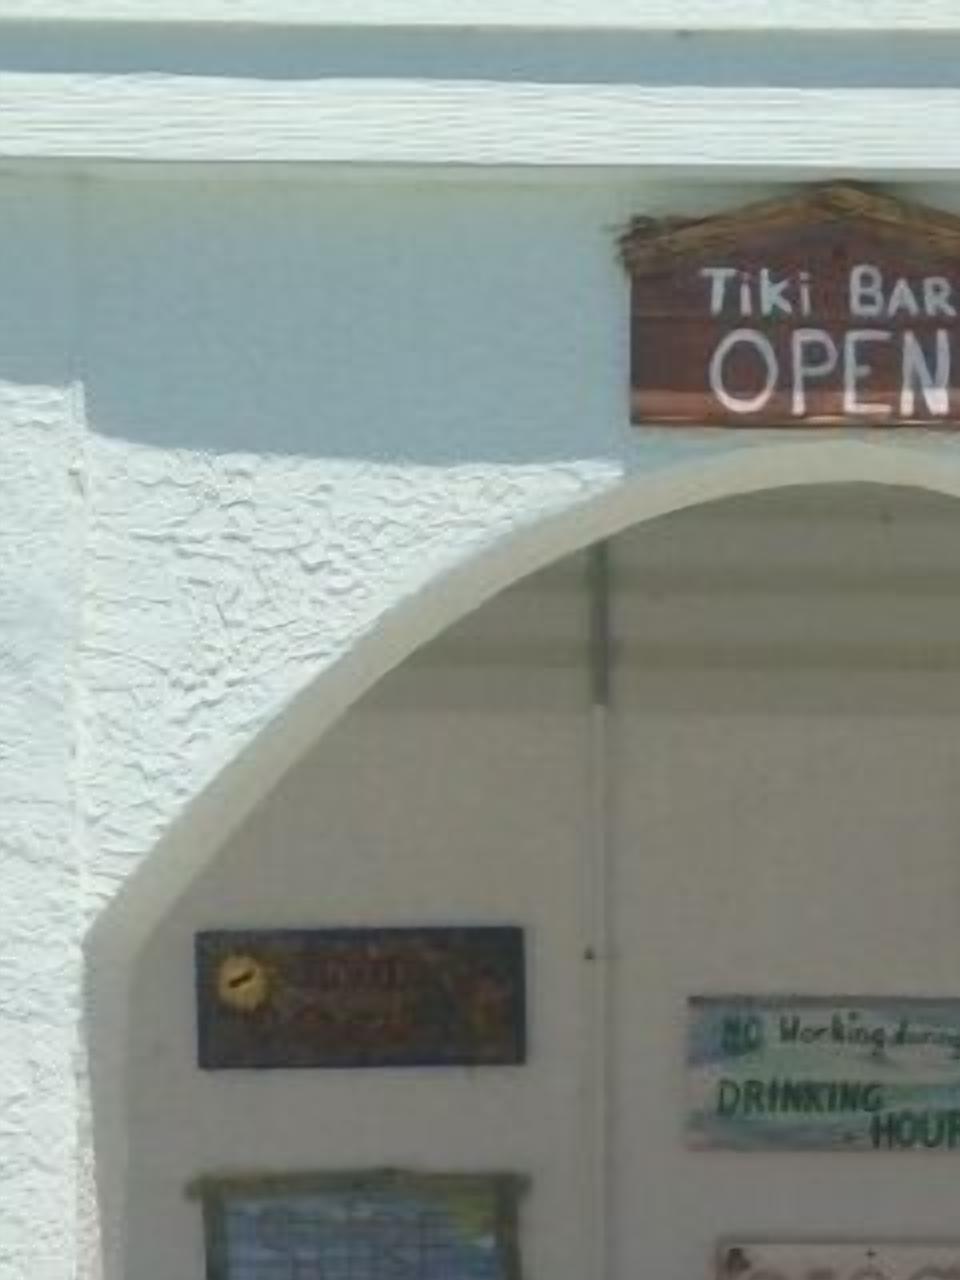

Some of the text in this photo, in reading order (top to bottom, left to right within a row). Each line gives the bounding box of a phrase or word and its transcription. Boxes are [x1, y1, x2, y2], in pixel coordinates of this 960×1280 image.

[702, 264, 957, 317] Tiki BAR
[709, 327, 952, 416] OPEN
[716, 1079, 885, 1117] DRINKING
